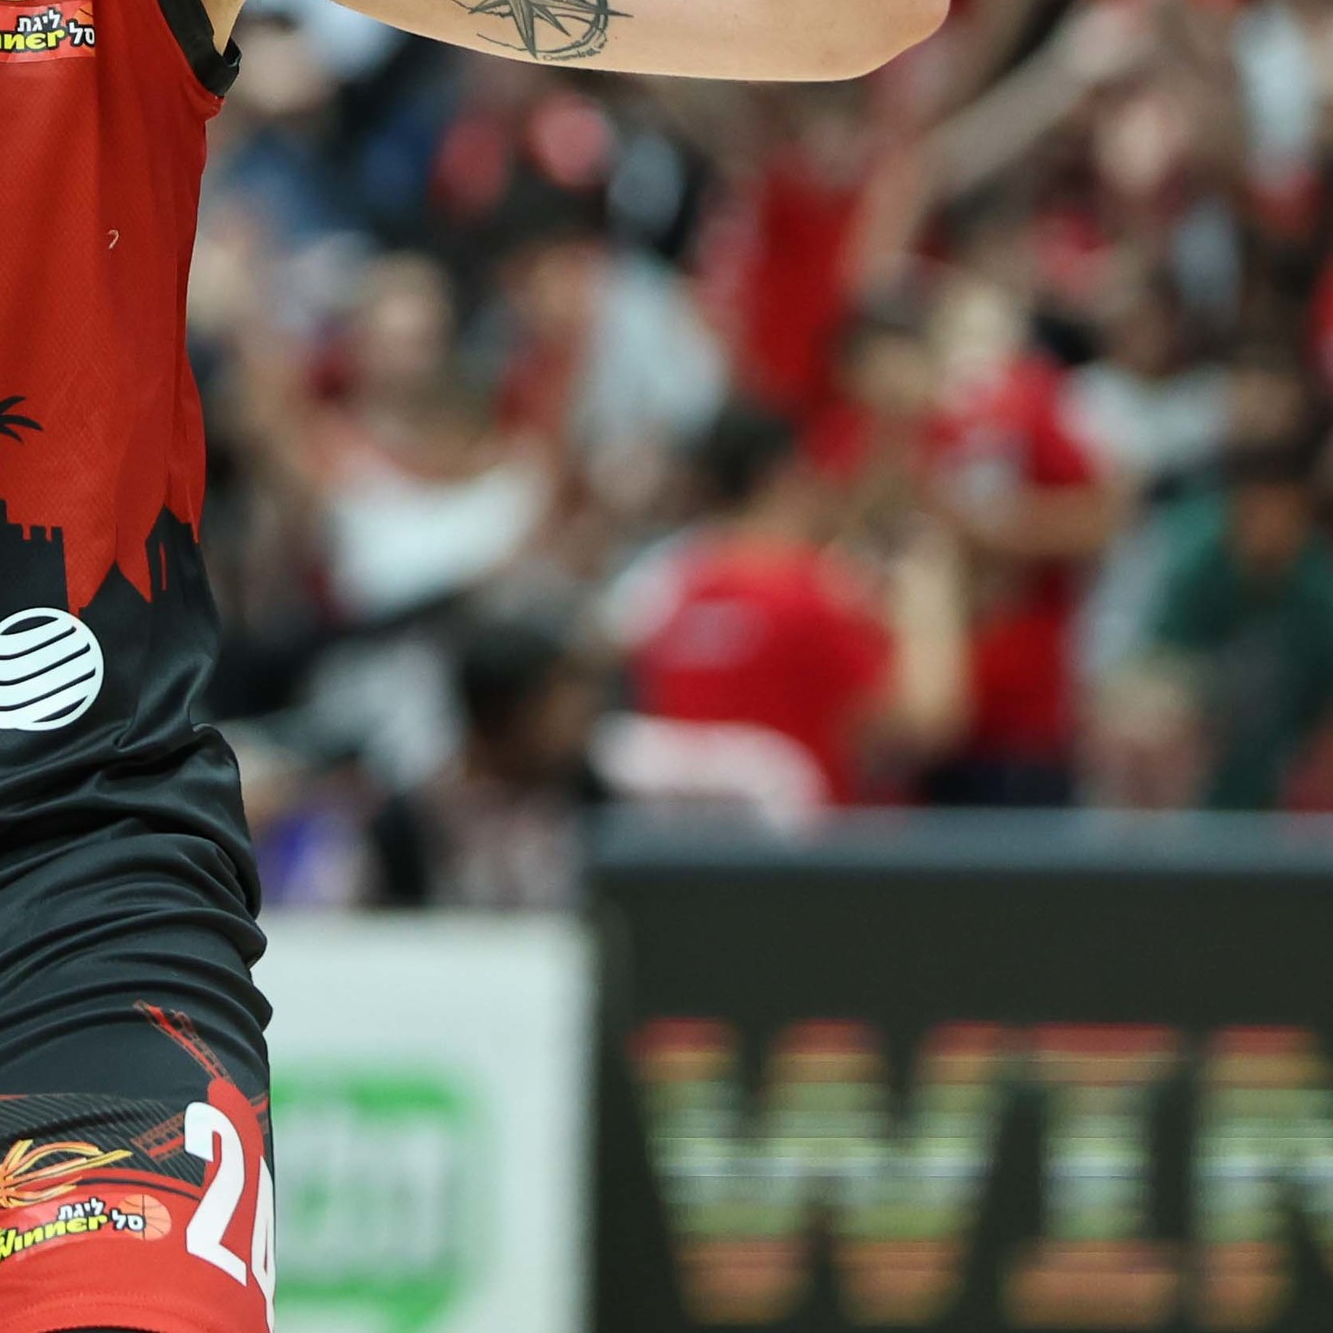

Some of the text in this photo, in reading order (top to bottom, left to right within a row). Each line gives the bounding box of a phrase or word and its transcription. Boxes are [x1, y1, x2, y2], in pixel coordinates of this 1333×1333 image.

[17, 8, 61, 32] ליגת
[69, 21, 95, 46] סל
[57, 1197, 103, 1221] ליגת
[111, 1209, 145, 1231] סל
